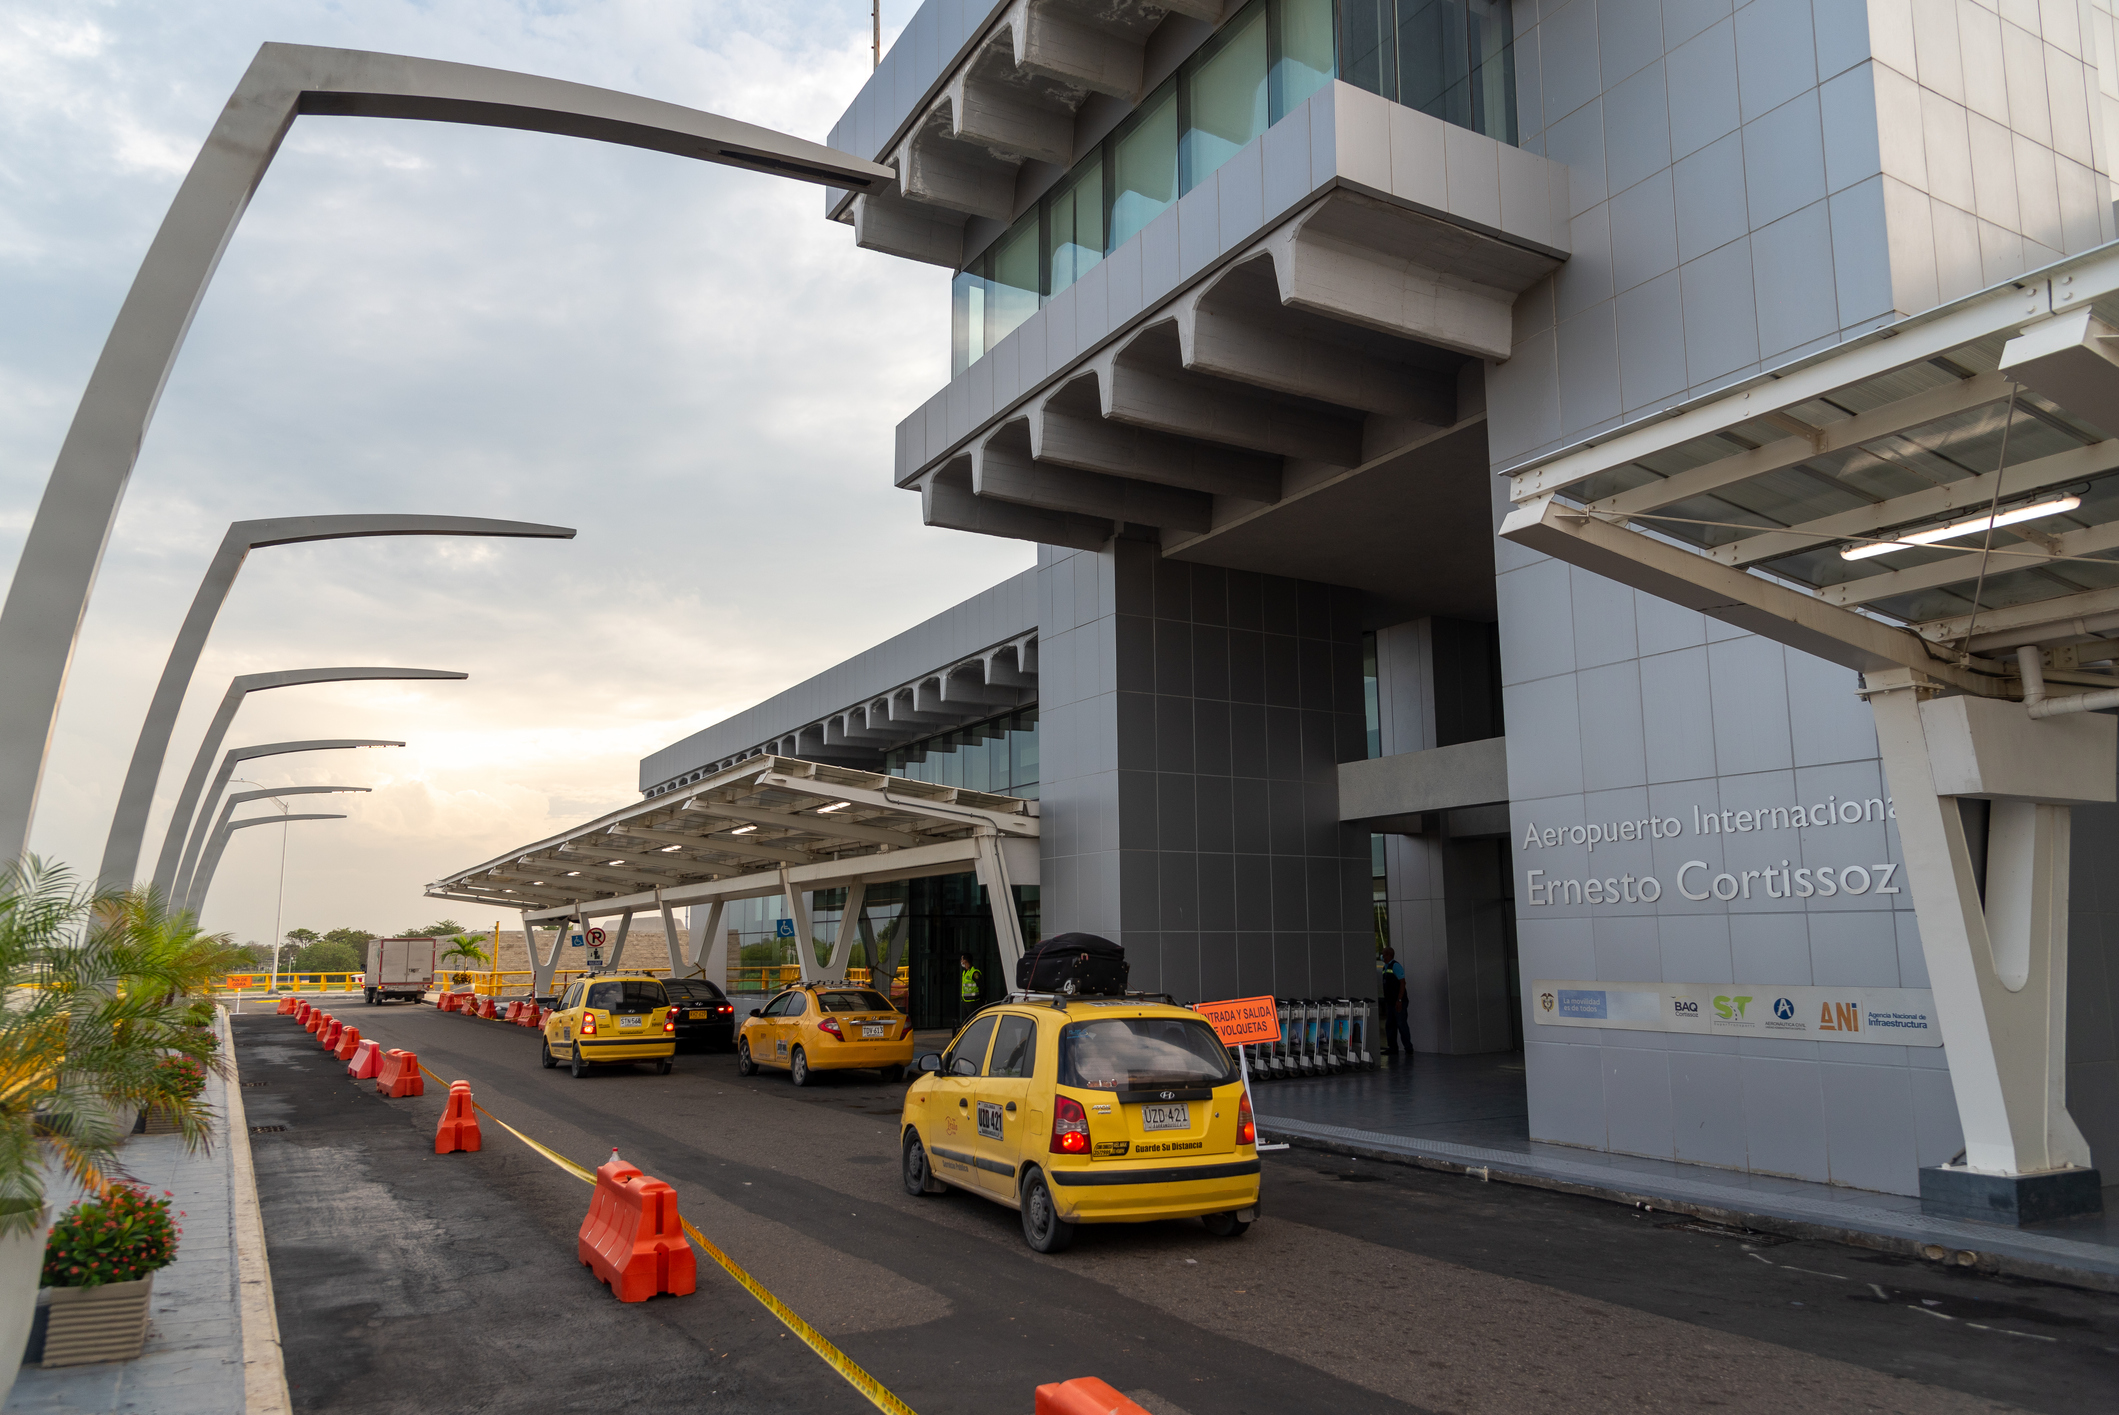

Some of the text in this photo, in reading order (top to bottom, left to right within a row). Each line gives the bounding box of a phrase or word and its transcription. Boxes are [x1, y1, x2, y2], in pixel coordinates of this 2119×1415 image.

[1522, 795, 1897, 853] Aeropuerto Internaciona
[1527, 859, 1902, 907] Ernesto Cortissoz
[1572, 998, 1600, 1006] movilidad
[1674, 1001, 1698, 1012] BAQ
[1202, 1006, 1271, 1022] NTRADA Y SALIDA
[1221, 1021, 1268, 1036] VOLQUETAS
[1868, 1018, 1928, 1029] Infraestructura
[990, 1111, 1002, 1132] 421
[1144, 1108, 1188, 1124] UZD 421
[1136, 1144, 1161, 1153] Guarde
[1162, 1143, 1171, 1152] Su
[1172, 1142, 1202, 1151] Distancia
